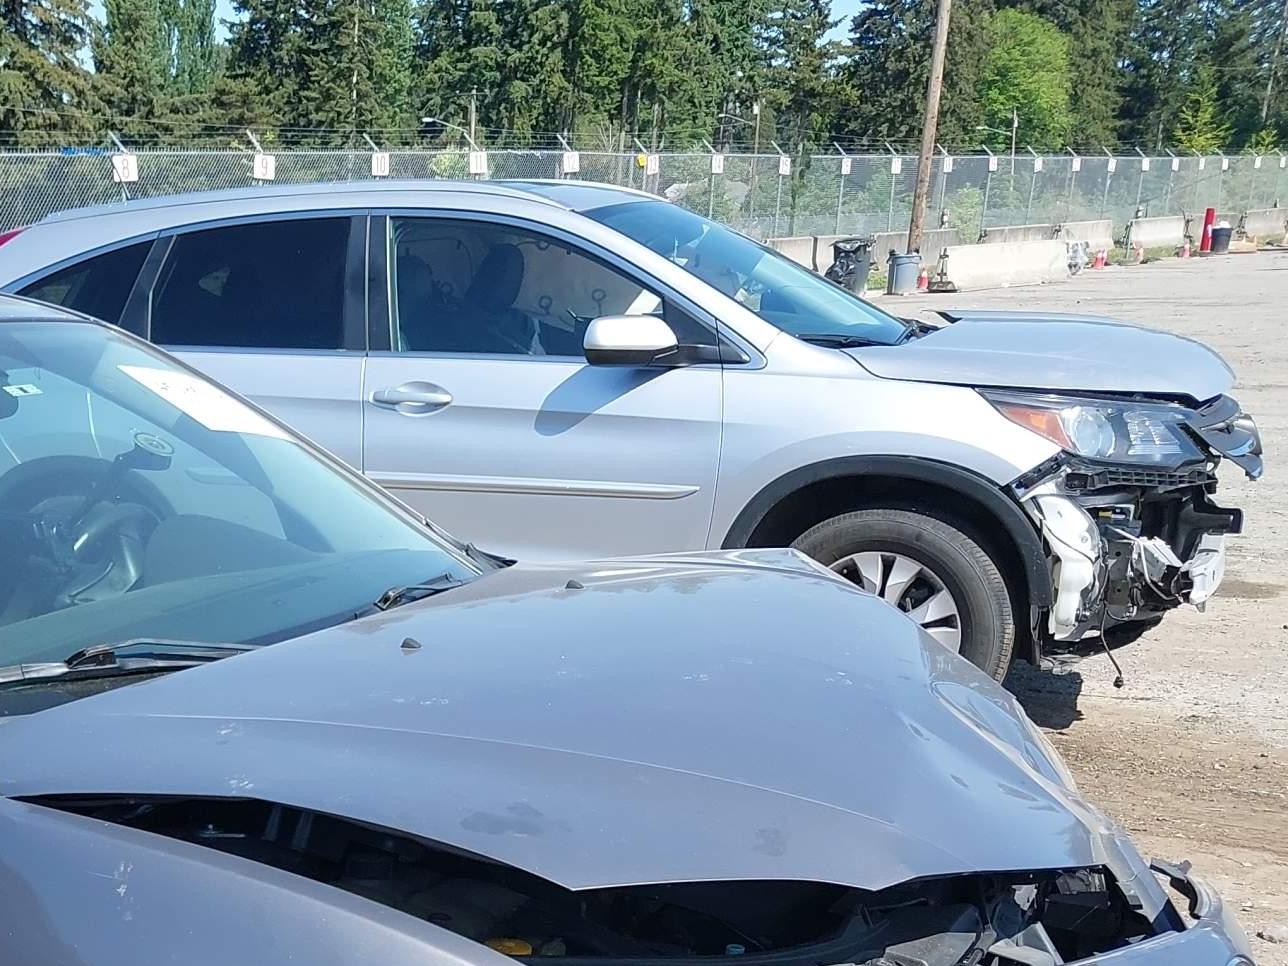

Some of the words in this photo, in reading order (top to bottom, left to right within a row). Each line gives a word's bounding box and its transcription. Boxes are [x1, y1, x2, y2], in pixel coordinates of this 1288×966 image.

[122, 158, 130, 180] 8
[261, 157, 268, 178] 9
[376, 154, 386, 175] 10
[475, 154, 482, 171] 11
